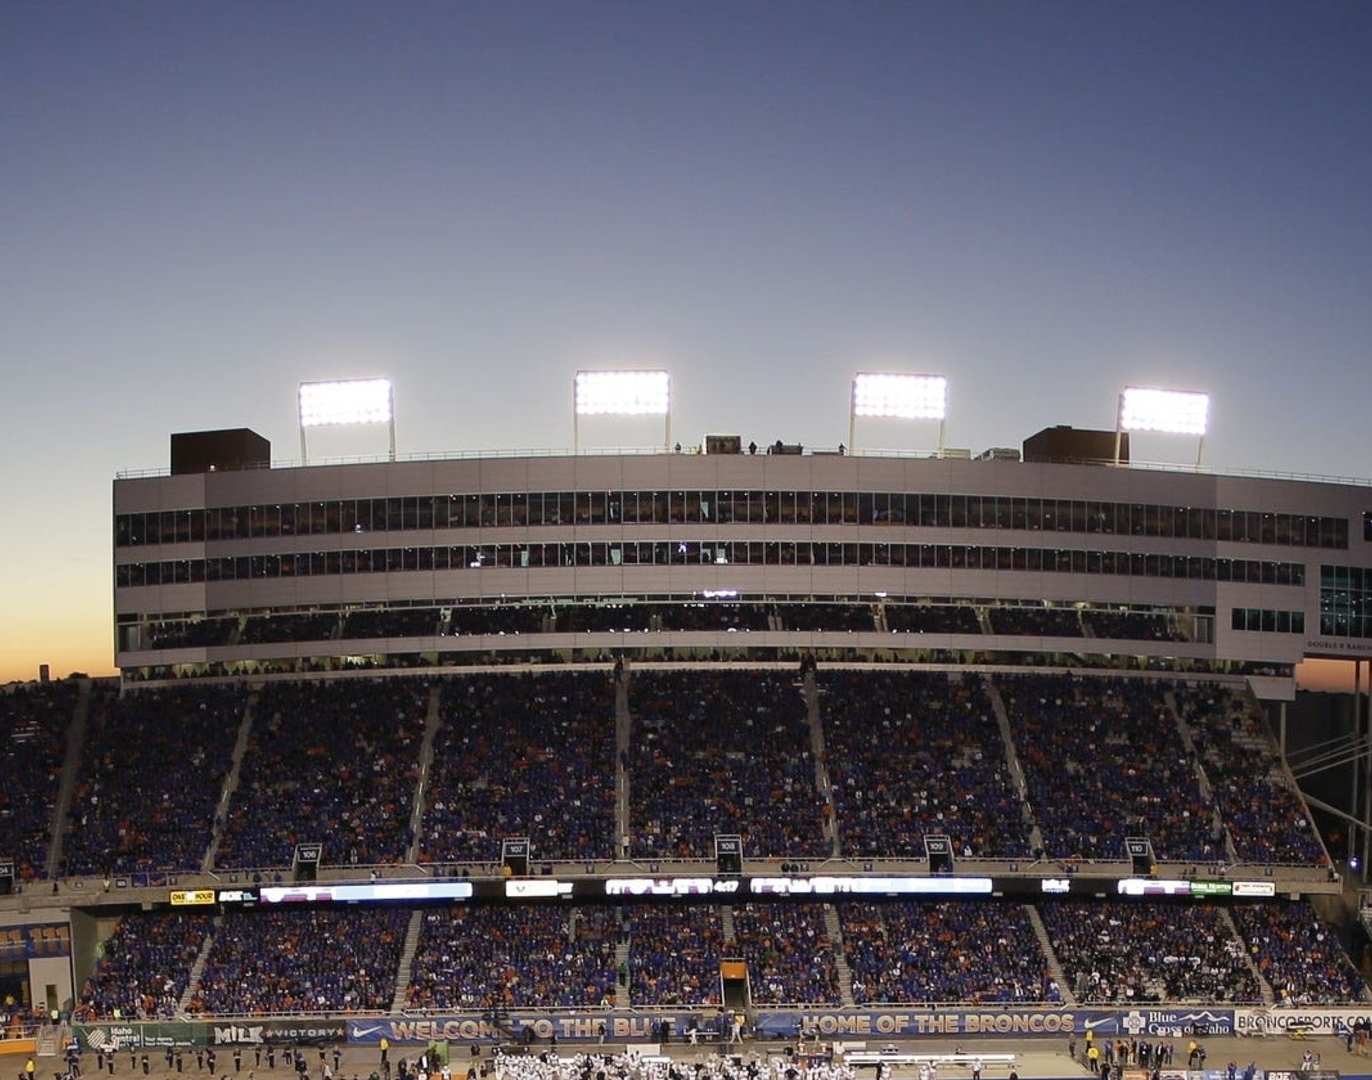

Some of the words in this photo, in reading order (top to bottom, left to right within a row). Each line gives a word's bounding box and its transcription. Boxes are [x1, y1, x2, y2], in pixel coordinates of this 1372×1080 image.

[802, 1014, 871, 1034] HOME
[878, 1014, 909, 1033] OF
[915, 1014, 959, 1033] THE
[964, 1013, 1076, 1033] BRONCOS
[1148, 1011, 1177, 1023] Blue
[110, 1026, 133, 1035] Idaho
[214, 1025, 264, 1045] MILK
[274, 1028, 336, 1038] VICTORY
[390, 1019, 514, 1040] WELCOME
[559, 1018, 608, 1038] THE
